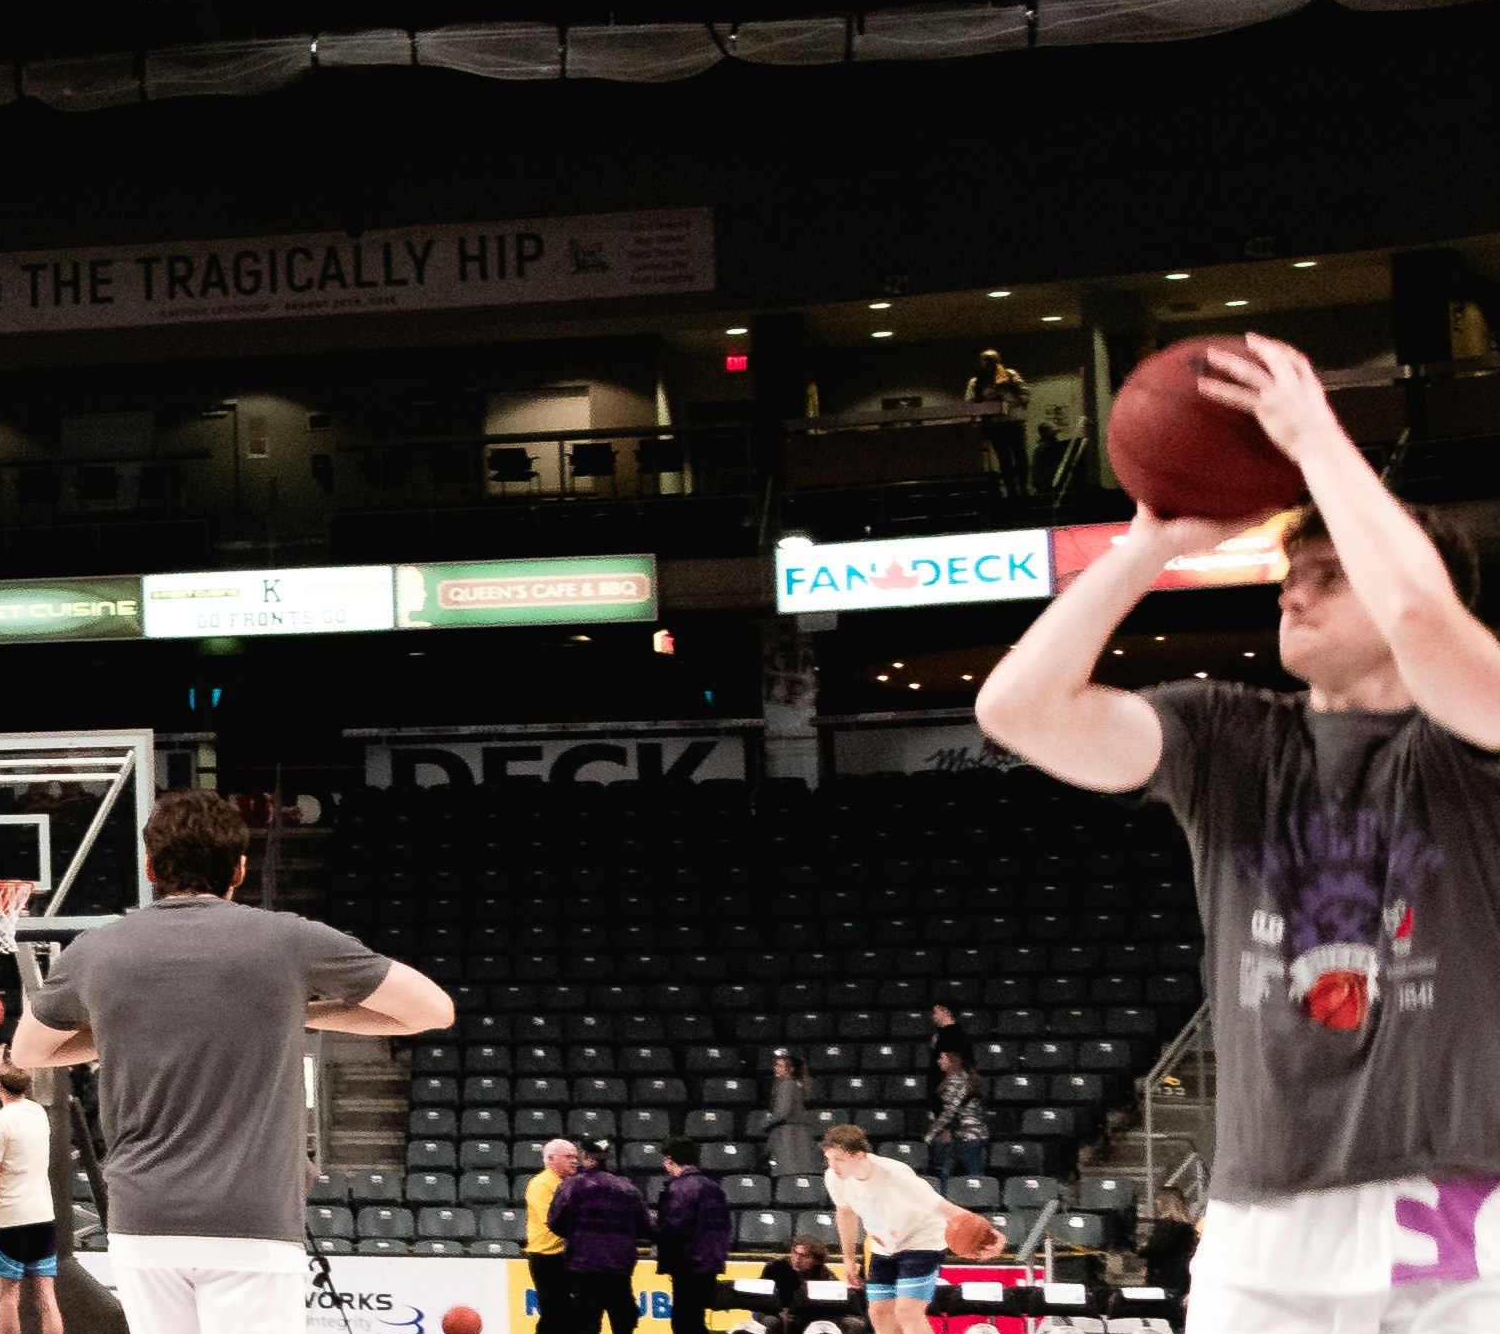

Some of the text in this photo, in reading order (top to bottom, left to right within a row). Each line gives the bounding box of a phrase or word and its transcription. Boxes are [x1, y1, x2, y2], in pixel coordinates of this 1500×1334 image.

[21, 232, 545, 307] THE TRAGICALLY HIP
[785, 552, 1038, 596] FAN DECK
[262, 579, 282, 603] K
[449, 581, 639, 604] QUEEN'S CAFE & BBQ
[29, 600, 138, 619] CUISINE
[197, 609, 347, 629] GO FRONTS GO
